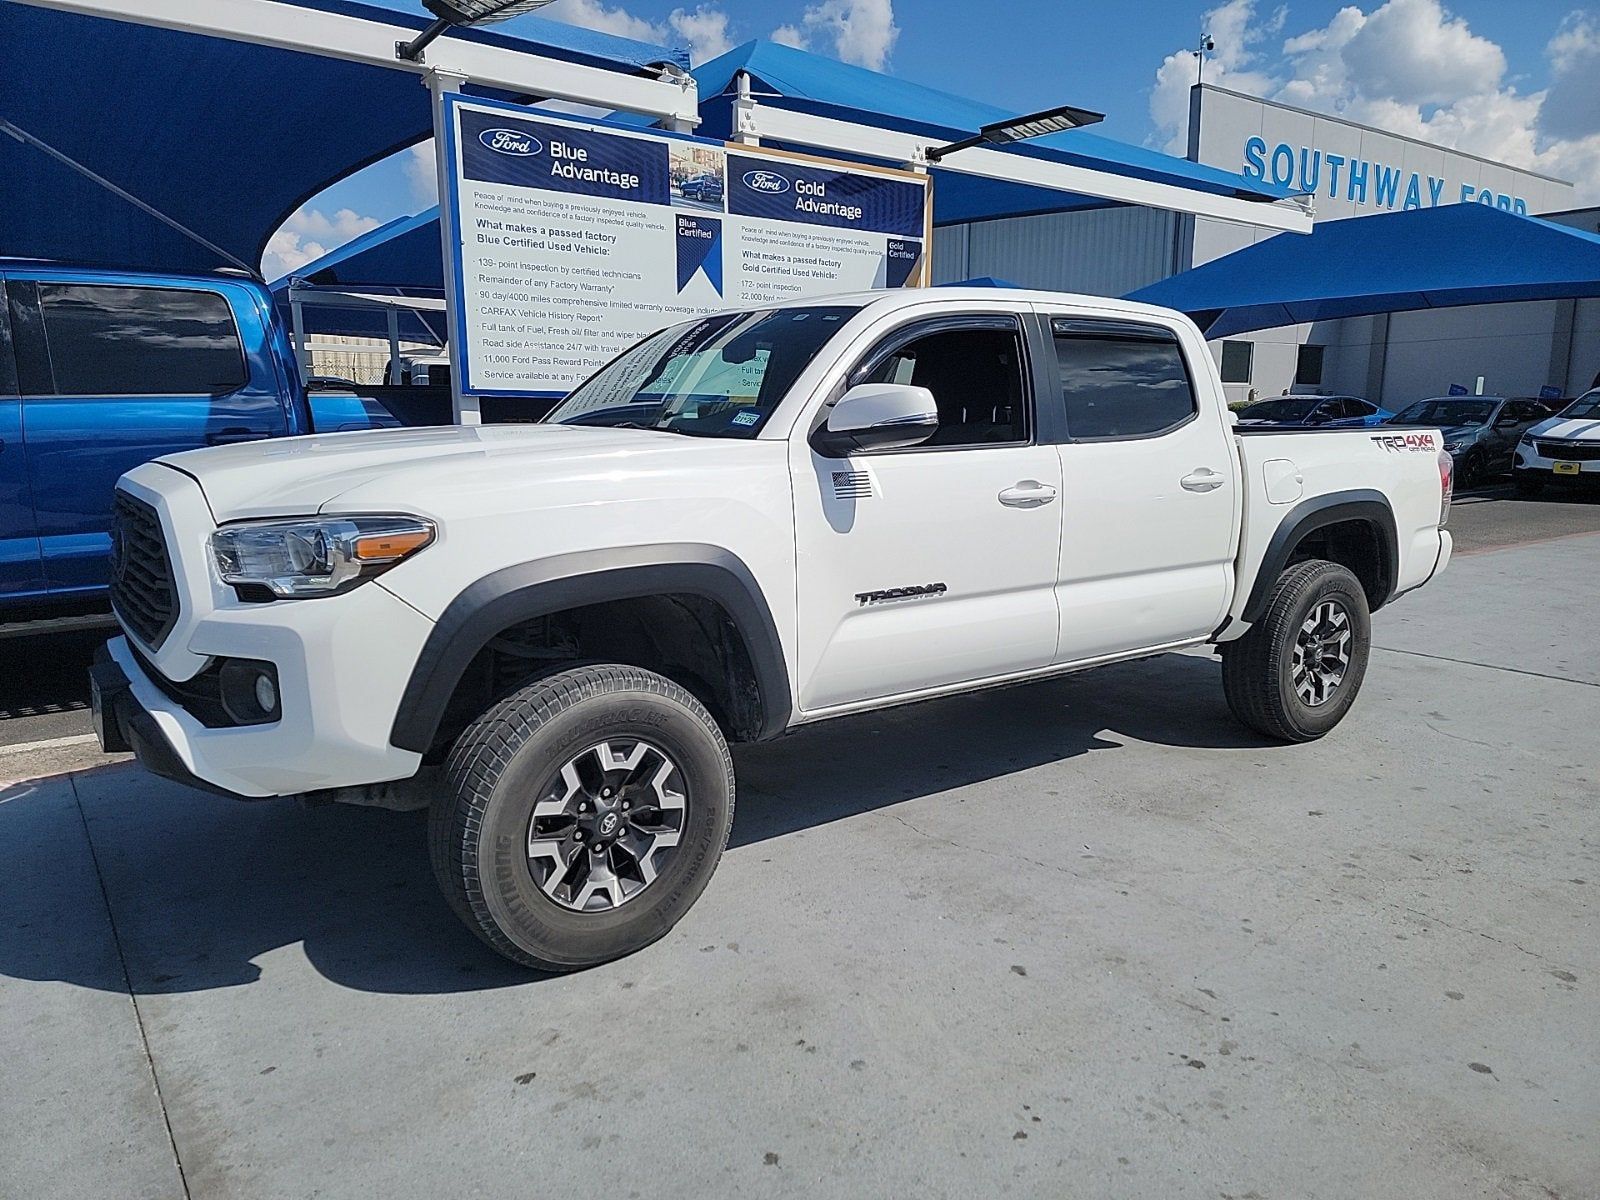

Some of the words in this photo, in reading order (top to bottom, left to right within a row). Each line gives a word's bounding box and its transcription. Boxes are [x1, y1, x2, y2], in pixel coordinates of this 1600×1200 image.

[491, 130, 531, 155] Ford
[550, 141, 587, 162] Blue
[551, 162, 639, 189] Advantage
[751, 171, 782, 192] Ford
[1243, 135, 1444, 212] SOUTHWAY
[795, 180, 825, 197] Gold
[474, 191, 496, 201] Peace
[507, 196, 523, 204] mind
[524, 198, 542, 207] when
[543, 200, 564, 210] buying
[570, 204, 600, 215] previously
[602, 208, 625, 218] enjoyed
[626, 211, 648, 219] vehicle.
[795, 197, 862, 219] Advantage
[474, 202, 512, 214] Knowledge
[527, 209, 560, 219] confidence
[574, 214, 595, 223] factory
[596, 217, 625, 226] inspected
[626, 221, 644, 229] quality
[645, 223, 667, 231] vehicle.
[677, 217, 697, 228] Blue
[476, 218, 503, 231] What
[505, 223, 538, 234] makes
[548, 228, 583, 239] passed
[585, 231, 617, 244] factory
[679, 226, 712, 239] Certified
[741, 226, 757, 234] Peace
[778, 230, 792, 238] when
[792, 232, 807, 241] buying
[812, 234, 835, 243] previously
[477, 233, 500, 245] Blue
[503, 236, 545, 249] Certified
[547, 241, 572, 252] Used
[574, 243, 610, 256] Vehicle:
[889, 241, 904, 251] Gold
[742, 250, 761, 260] What
[762, 252, 785, 262] makes
[792, 256, 817, 266] passed
[818, 258, 841, 269] factory
[889, 250, 915, 260] Certified
[498, 261, 518, 269] point
[520, 261, 558, 273] inspection
[560, 265, 570, 275] by
[571, 267, 600, 277] certified
[742, 263, 760, 272] Gold
[761, 265, 791, 275] Certified
[792, 268, 810, 277] Used
[811, 269, 838, 280] Vehicle:
[478, 274, 522, 286] Remainder
[524, 278, 532, 286] of
[534, 280, 549, 289] any
[550, 280, 579, 292] Factory
[756, 282, 771, 290] point
[772, 283, 802, 292] inspection
[479, 290, 490, 299] 90
[530, 294, 551, 303] miles
[552, 296, 608, 308] comprehensive
[609, 300, 632, 309] limited
[634, 303, 663, 312] warranty
[665, 306, 694, 315] coverage
[480, 306, 517, 317] CARFAX
[518, 310, 547, 319] Vehicle
[548, 312, 575, 322] History
[481, 323, 497, 331] Full
[498, 325, 516, 333] tank
[517, 325, 525, 333] of
[548, 326, 569, 336] Fresh
[584, 328, 600, 337] filter
[616, 331, 635, 339] wiper
[482, 338, 504, 348] Road
[505, 340, 523, 349] side
[524, 341, 565, 351] Assistance
[566, 343, 583, 351] 24/7
[584, 344, 599, 352] with
[484, 355, 510, 364] 11,000
[512, 356, 530, 364] Ford
[532, 356, 551, 365] Pass
[553, 357, 582, 366] Reward
[484, 370, 514, 380] Service
[516, 371, 550, 380] available
[552, 373, 559, 381] at
[560, 374, 574, 382] any
[1370, 435, 1407, 453] TRD
[855, 582, 948, 607] TACOMA
